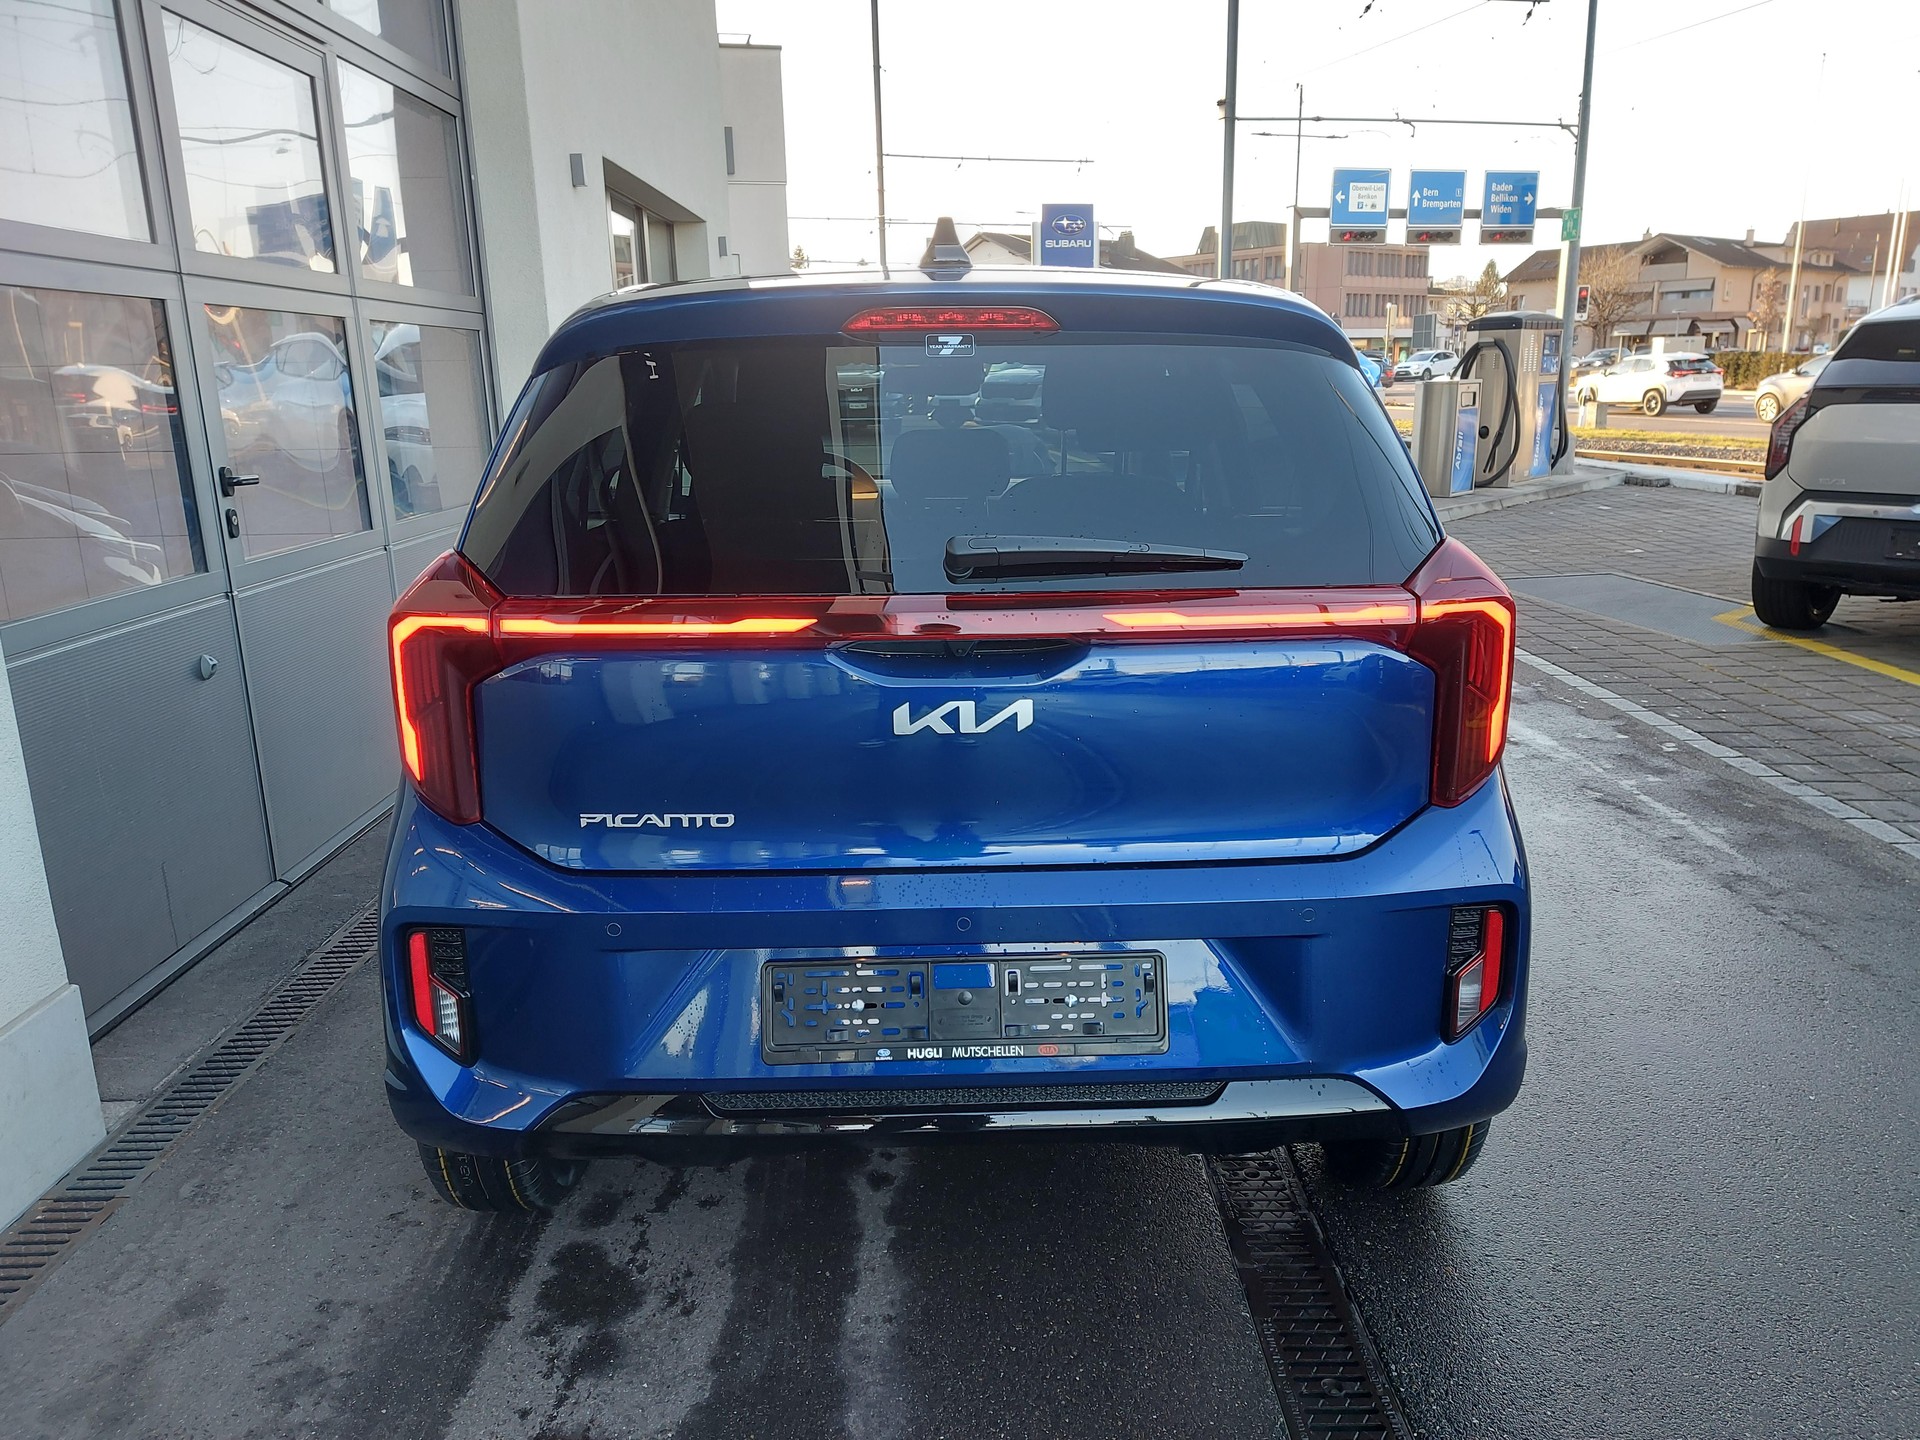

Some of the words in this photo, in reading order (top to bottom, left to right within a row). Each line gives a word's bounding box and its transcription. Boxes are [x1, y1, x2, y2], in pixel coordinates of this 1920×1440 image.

[1351, 184, 1385, 192] Oberwil-Lieli
[1491, 182, 1513, 191] Baden
[1423, 187, 1439, 197] Bern
[1490, 193, 1518, 203] Bellikon
[1422, 199, 1461, 210] Bremgarten
[1490, 204, 1512, 214] Widen
[1045, 239, 1092, 248] SUBARU
[938, 336, 963, 355] 7
[1455, 431, 1464, 470] Abfall
[893, 698, 1035, 736] KIA
[579, 813, 735, 829] PICANTO
[907, 1047, 943, 1059] HUGLI
[951, 1045, 1024, 1058] MUTSCHELLEN
